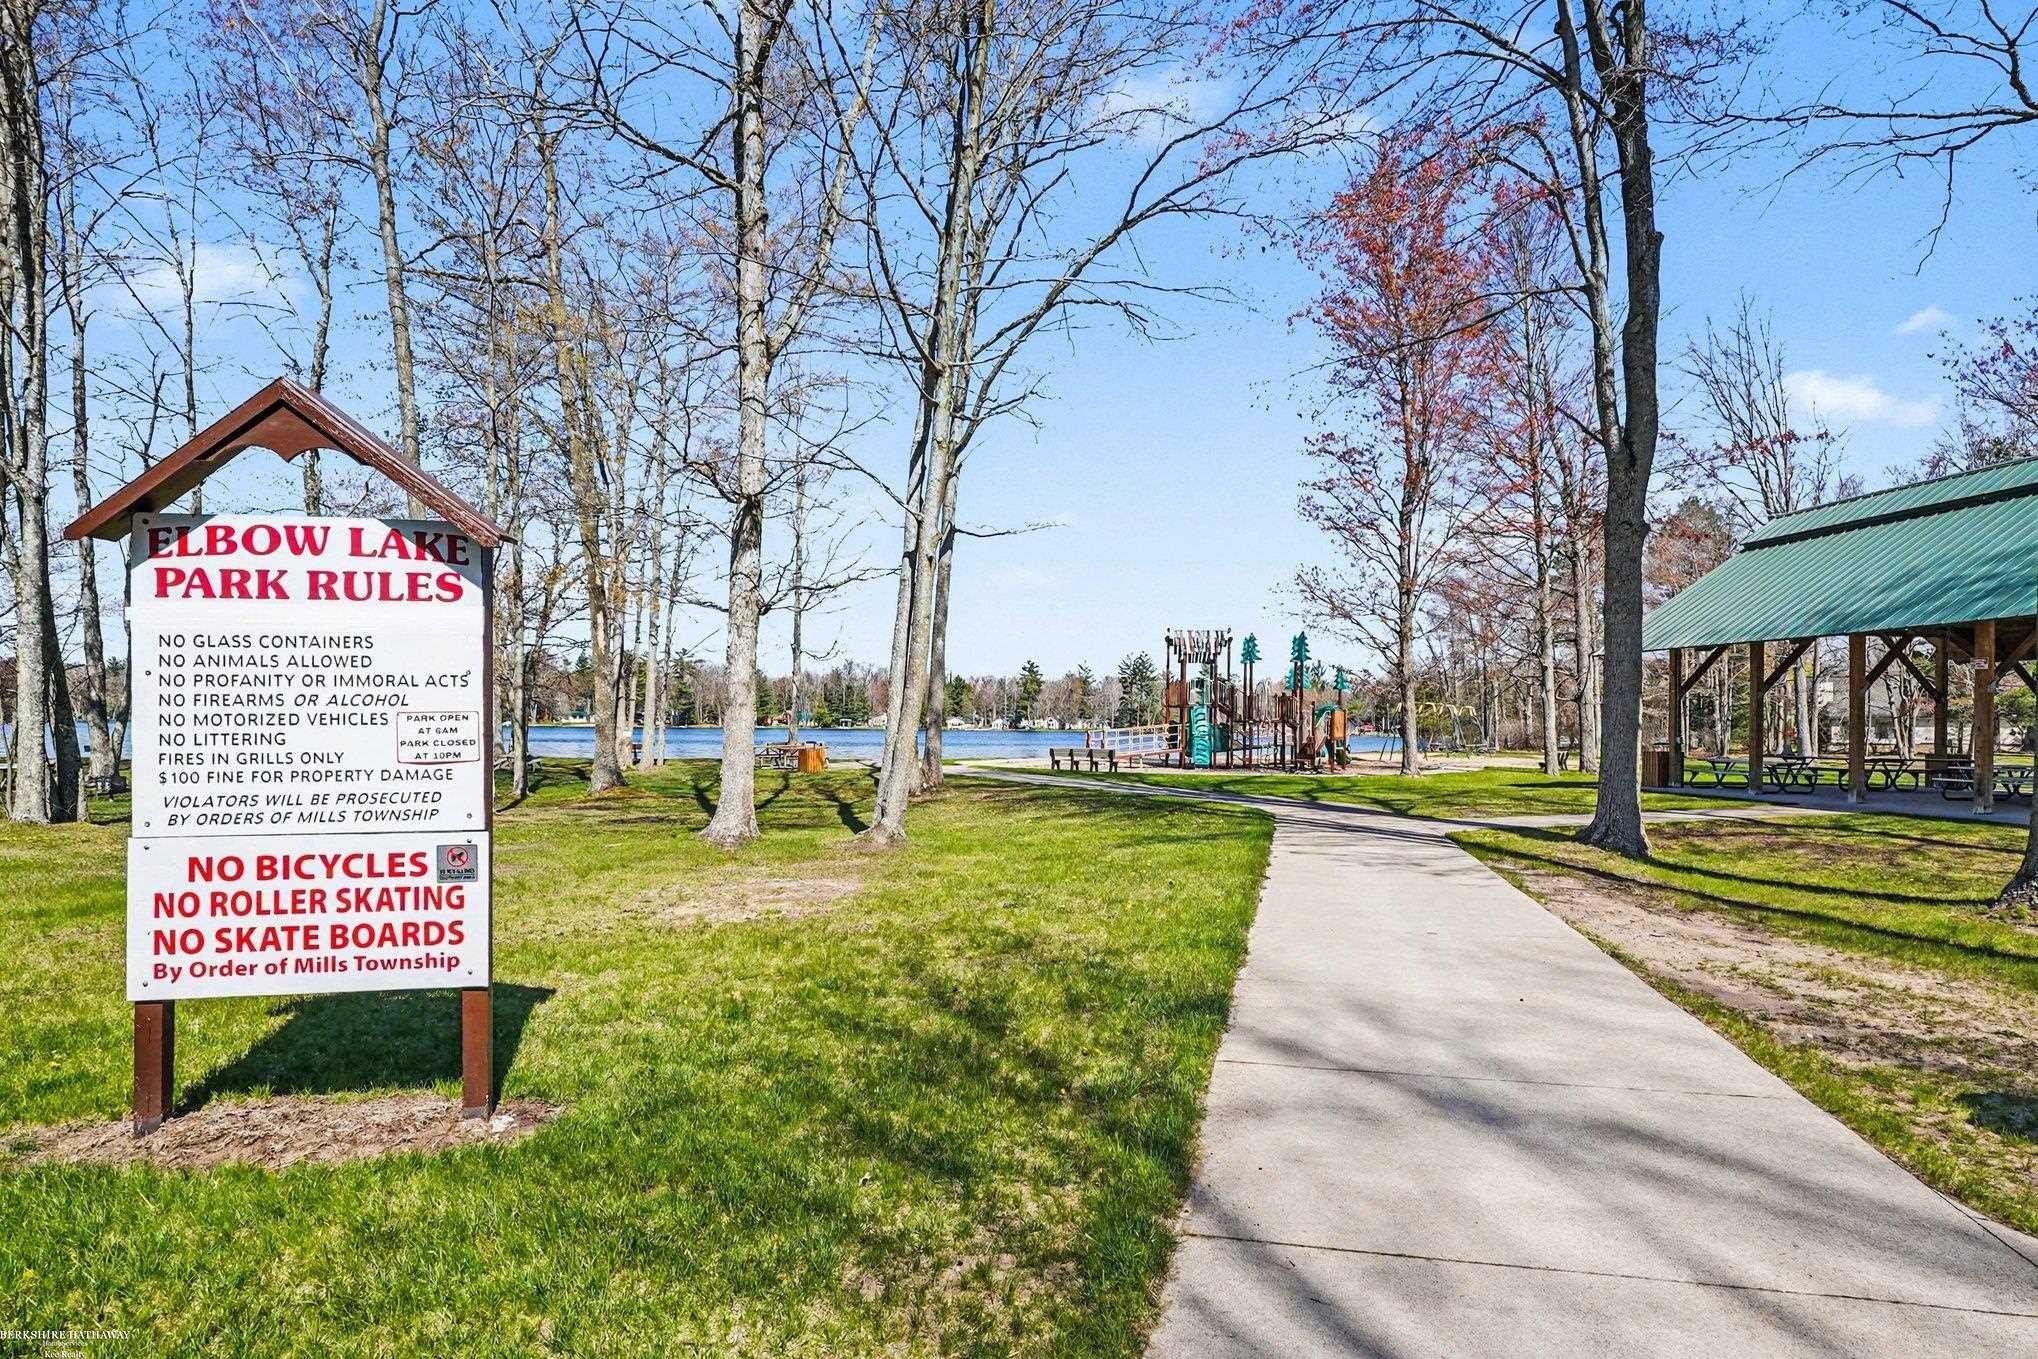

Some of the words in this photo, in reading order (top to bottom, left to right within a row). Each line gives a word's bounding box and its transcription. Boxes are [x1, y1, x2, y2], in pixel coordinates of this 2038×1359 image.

[147, 524, 330, 559] ELBOW
[348, 527, 470, 566] LAKE
[154, 568, 289, 599] PARK
[307, 570, 464, 602] RULES
[158, 634, 186, 649] NO
[192, 634, 252, 649] GLASS
[259, 634, 374, 650] CONTAINERS
[158, 653, 186, 668] NO
[192, 654, 279, 668] ANIMALS
[286, 654, 373, 669] ALLOWED
[159, 673, 186, 688] NO
[193, 673, 296, 688] PROFANITY
[301, 673, 326, 688] OR
[333, 674, 420, 688] IMMORAL
[424, 673, 470, 688] ACTS
[158, 693, 186, 708] NO
[193, 693, 285, 707] FIREARMS
[294, 693, 319, 707] OR
[325, 693, 409, 707] ALCOHOL
[159, 713, 186, 727] NO
[193, 712, 300, 727] MOTORIZED
[306, 712, 389, 726] VEHICLES
[406, 714, 436, 723] PARK
[439, 714, 470, 722] OPEN
[417, 726, 432, 735] AT
[435, 726, 459, 735] 6AM
[159, 732, 186, 747] NO
[193, 732, 286, 747] LITTERING
[399, 739, 430, 748] PARK
[432, 738, 477, 747] CLOSED
[158, 752, 205, 766] FIRES
[211, 752, 229, 766] IN
[236, 751, 294, 765] GRILLS
[300, 751, 345, 765] ONLY
[414, 752, 429, 760] AT
[433, 751, 462, 760] 10PM
[158, 771, 200, 785] $100
[207, 770, 245, 784] FINE
[251, 770, 284, 783] FOR
[290, 769, 374, 783] PROPERTY
[380, 768, 453, 782] DAMAGE
[164, 794, 259, 809] VIOLATORS
[266, 793, 303, 807] WILL
[310, 793, 331, 806] BE
[335, 791, 442, 805] PROSECUTED
[167, 813, 191, 827] BY
[196, 811, 265, 826] ORDERS
[270, 811, 293, 825] OF
[297, 810, 347, 824] MILLS
[353, 808, 440, 822] TOWNSHIP
[188, 856, 244, 882] NO
[257, 852, 428, 881] BICYCLES
[154, 892, 200, 918] NO
[211, 889, 327, 917] ROLLER
[336, 885, 464, 913] SKATING
[154, 929, 204, 955] NO
[215, 925, 319, 953] SKATE
[331, 920, 464, 949] BOARDS
[154, 963, 182, 984] By
[190, 960, 258, 977] Order
[265, 958, 288, 975] of
[295, 956, 347, 973] Mills
[354, 952, 460, 972] Township
